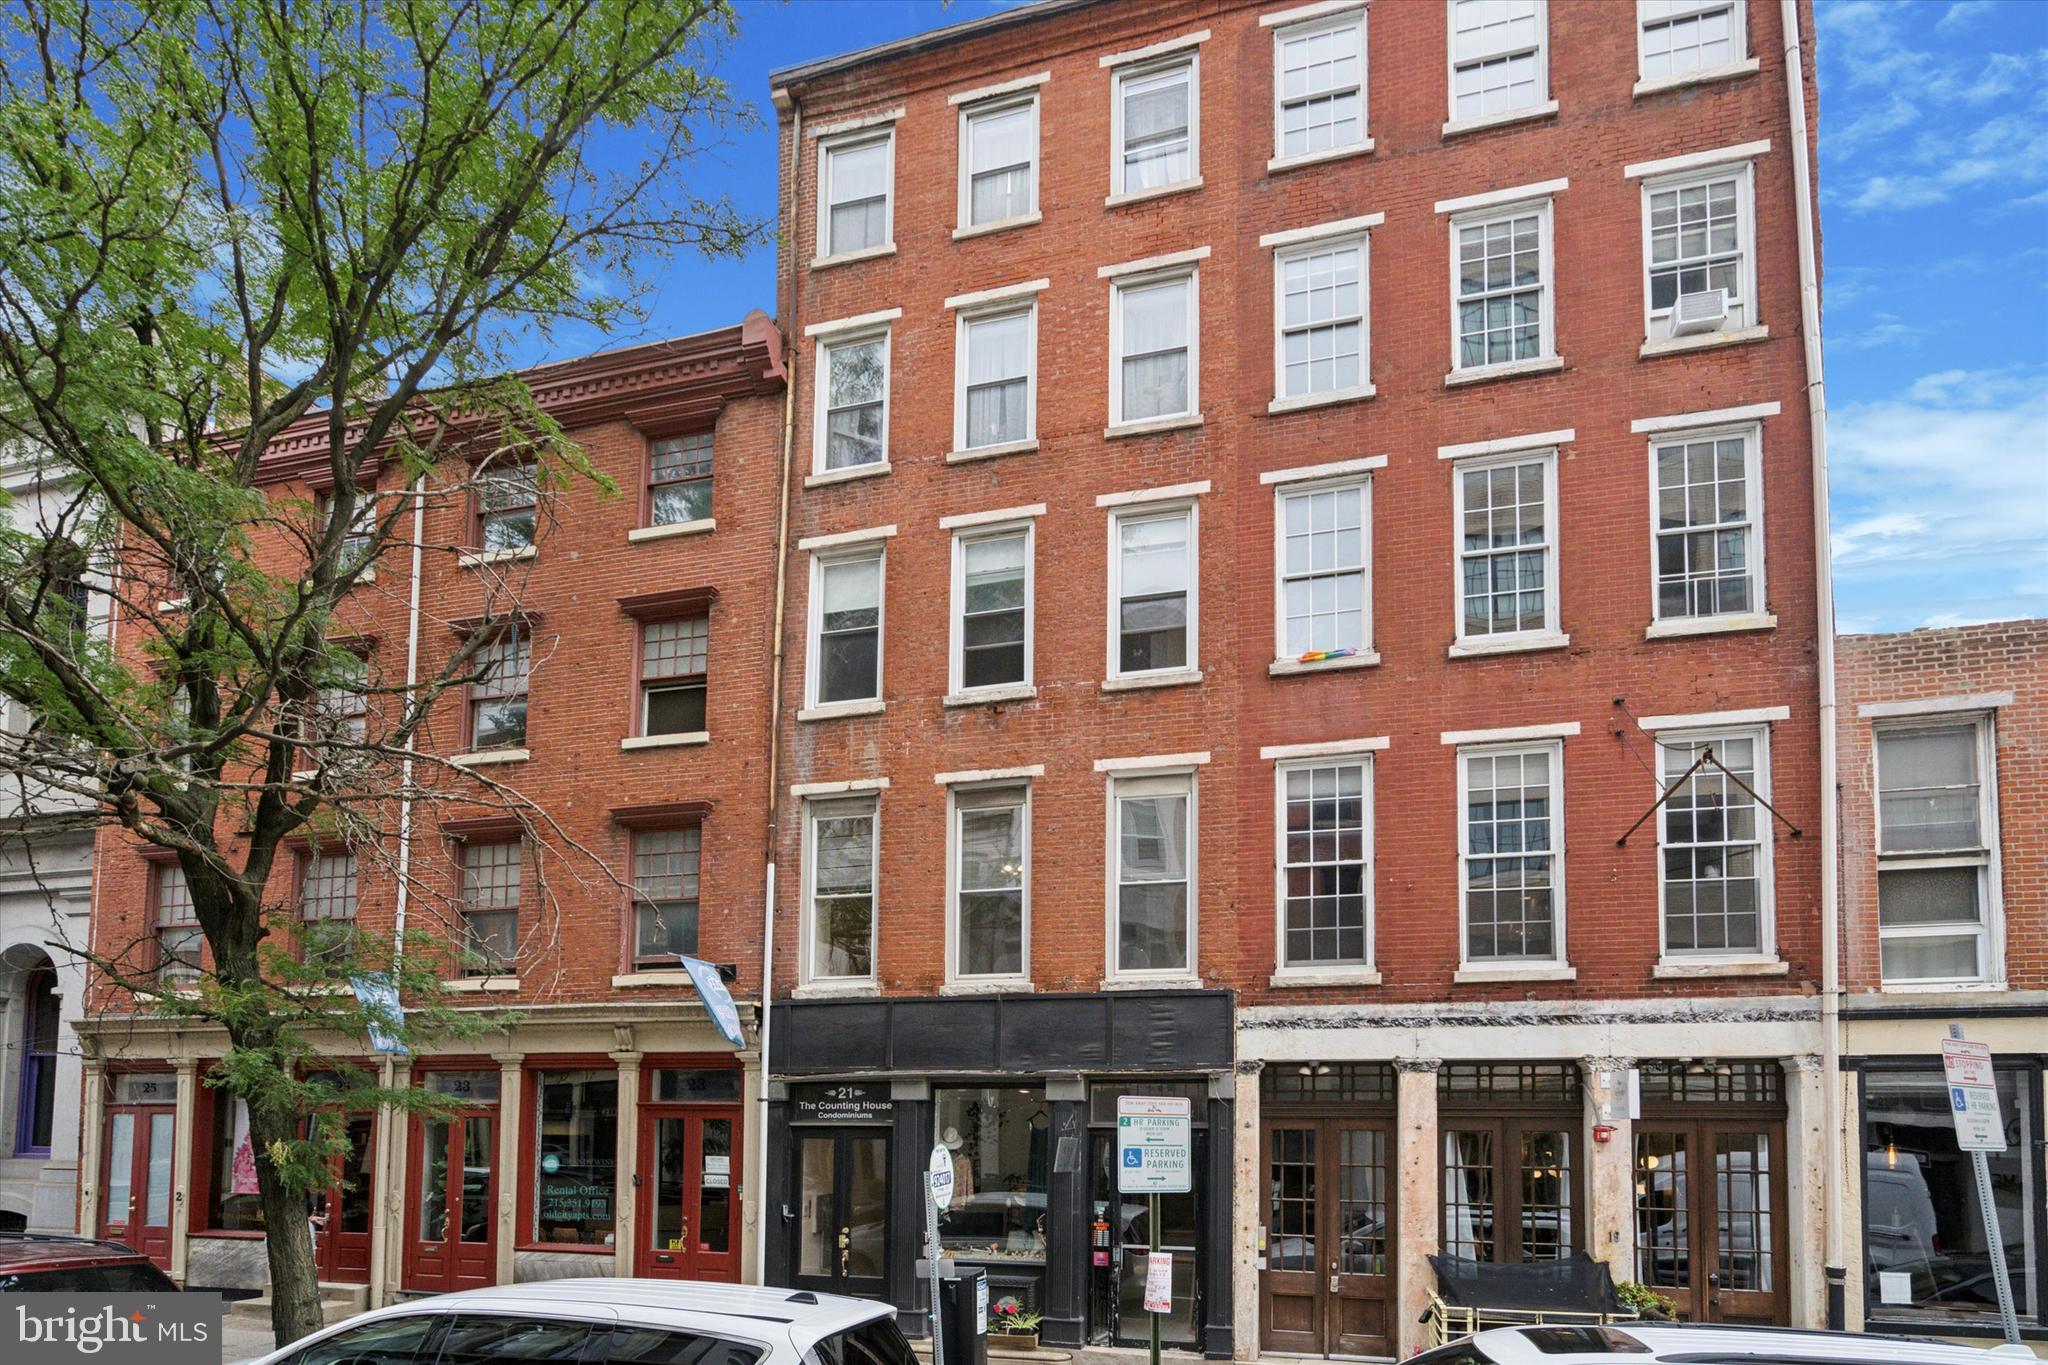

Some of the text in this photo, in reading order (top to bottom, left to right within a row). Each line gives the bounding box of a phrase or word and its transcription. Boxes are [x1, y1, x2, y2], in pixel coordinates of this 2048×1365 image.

[143, 1083, 157, 1093] 25
[454, 1080, 471, 1092] 23
[838, 1087, 853, 1099] 21
[800, 1101, 893, 1111] The Counting House
[817, 1111, 873, 1119] Condominiums
[1123, 1117, 1129, 1125] 2
[1147, 1119, 1180, 1127] PARKING
[1144, 1148, 1187, 1158] RESERVED
[1146, 1160, 1184, 1169] PARKING
[546, 1184, 610, 1196] Rental Office
[175, 1191, 183, 1201] 2
[1149, 1256, 1171, 1265] ARKING
